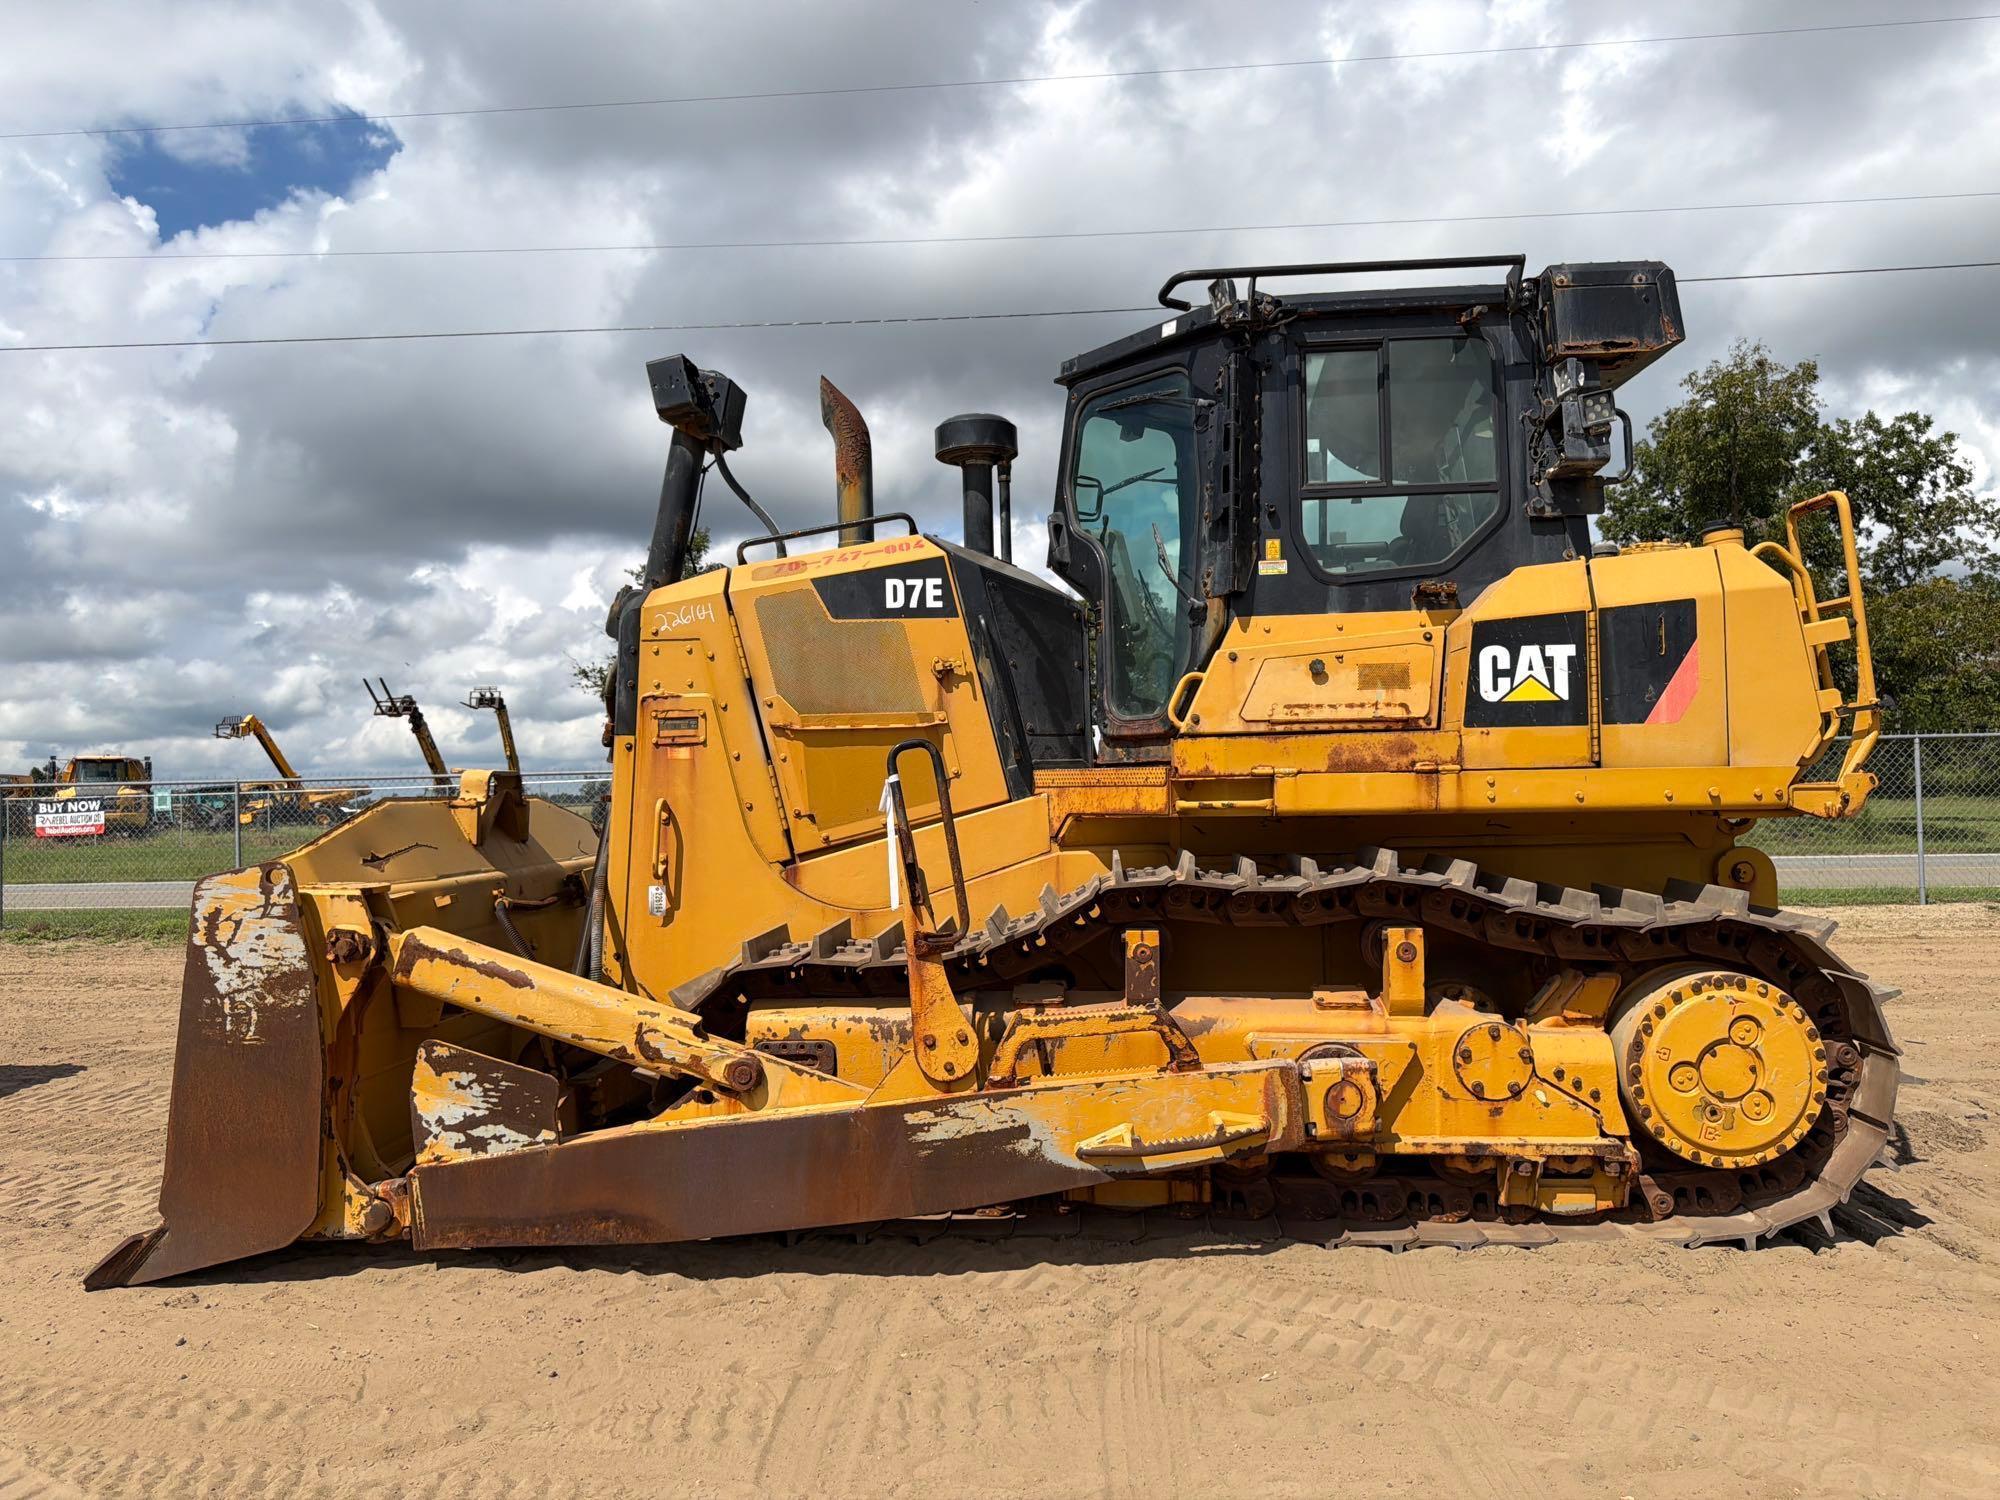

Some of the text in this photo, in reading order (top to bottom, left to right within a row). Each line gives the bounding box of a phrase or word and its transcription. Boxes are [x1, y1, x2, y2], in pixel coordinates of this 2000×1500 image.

[885, 578, 943, 608] D7E
[655, 603, 715, 631] 226164
[1479, 644, 1576, 702] CAT
[39, 800, 100, 814] BUY NOW
[51, 815, 69, 825] REBEL
[70, 814, 93, 824] AUCTION
